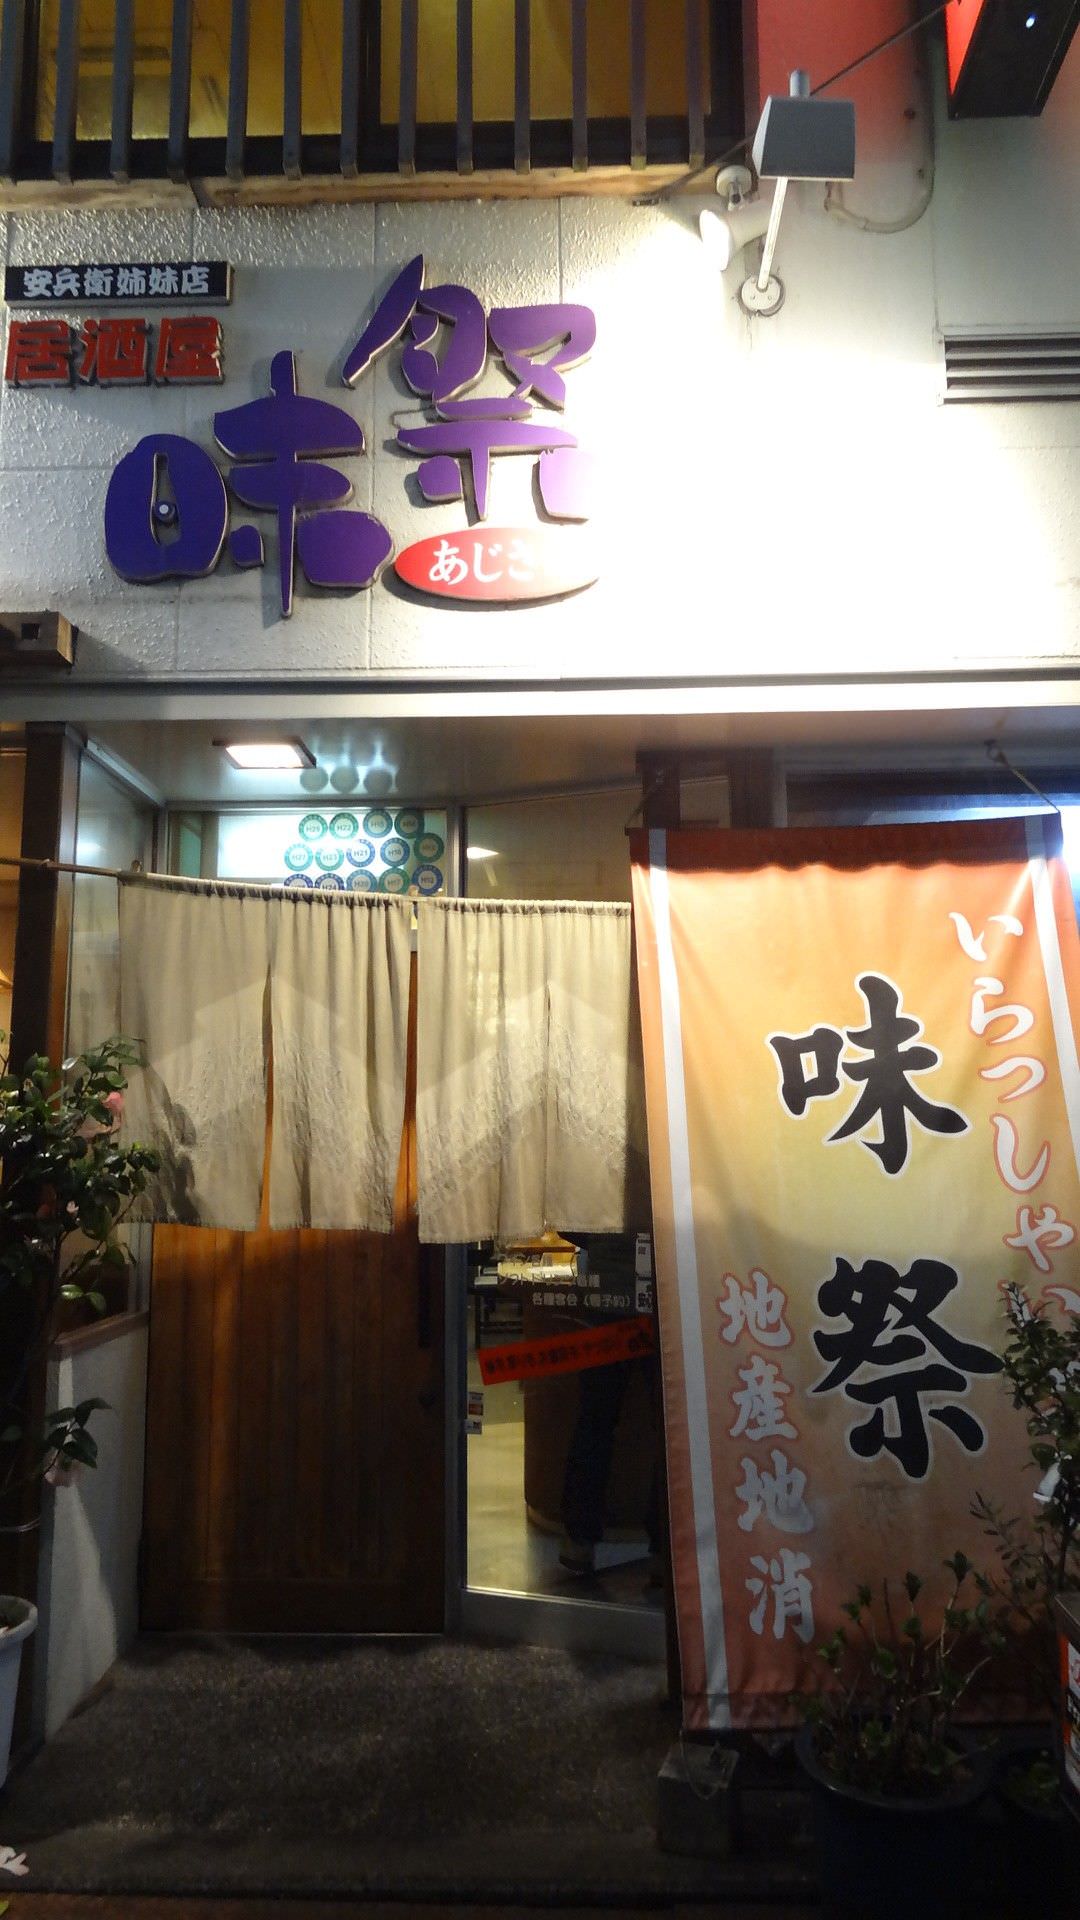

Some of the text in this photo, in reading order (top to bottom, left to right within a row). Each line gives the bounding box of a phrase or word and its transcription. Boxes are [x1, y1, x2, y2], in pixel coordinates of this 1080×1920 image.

[24, 266, 210, 298] 安兵衛姉妹店
[5, 315, 223, 386] 居酒屋
[428, 538, 536, 587] あじさ
[769, 974, 1004, 1477] 味祭
[718, 1270, 816, 1645] 地産地消
